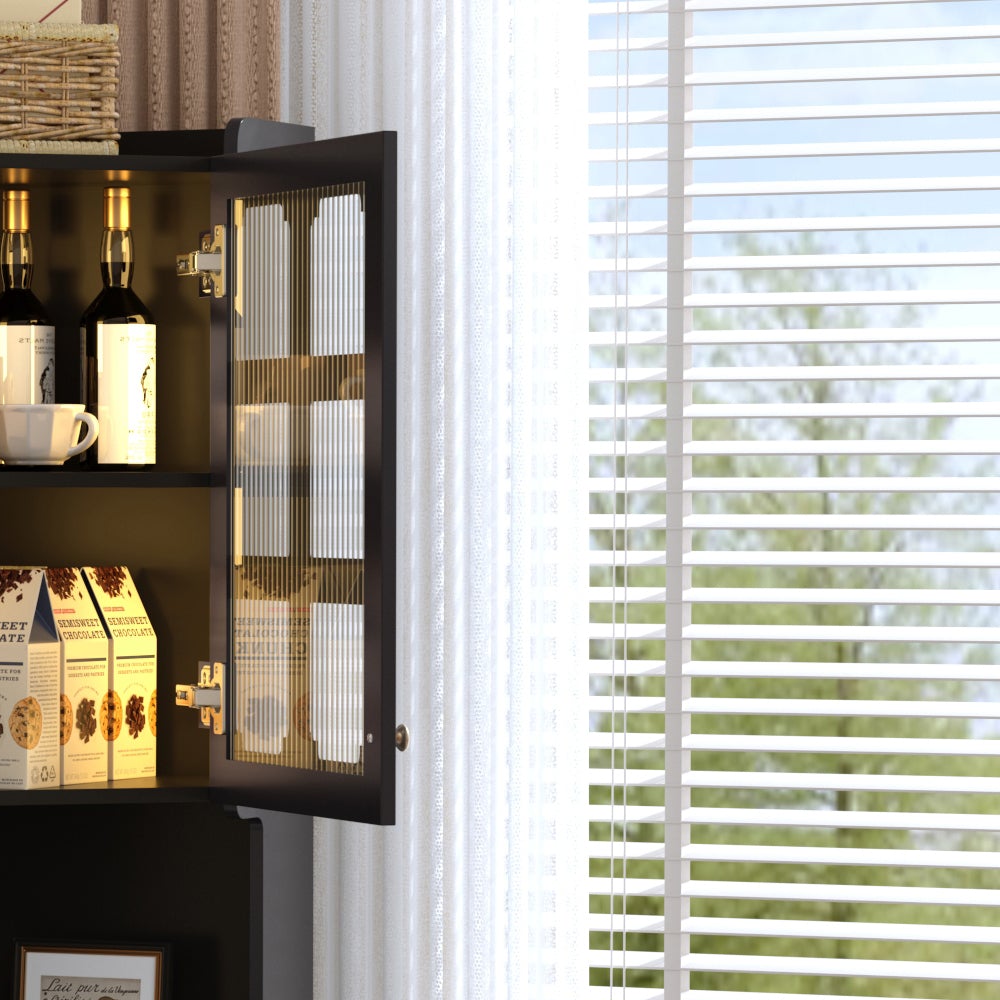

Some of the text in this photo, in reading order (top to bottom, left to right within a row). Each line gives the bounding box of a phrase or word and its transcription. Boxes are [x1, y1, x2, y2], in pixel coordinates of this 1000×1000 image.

[57, 618, 100, 628] SEMISWEET
[107, 616, 149, 626] SEMISWEET
[62, 630, 106, 640] CHOCOLATE
[112, 628, 154, 638] CHOCOLATE
[41, 977, 72, 993] Lait
[74, 983, 100, 996] pur
